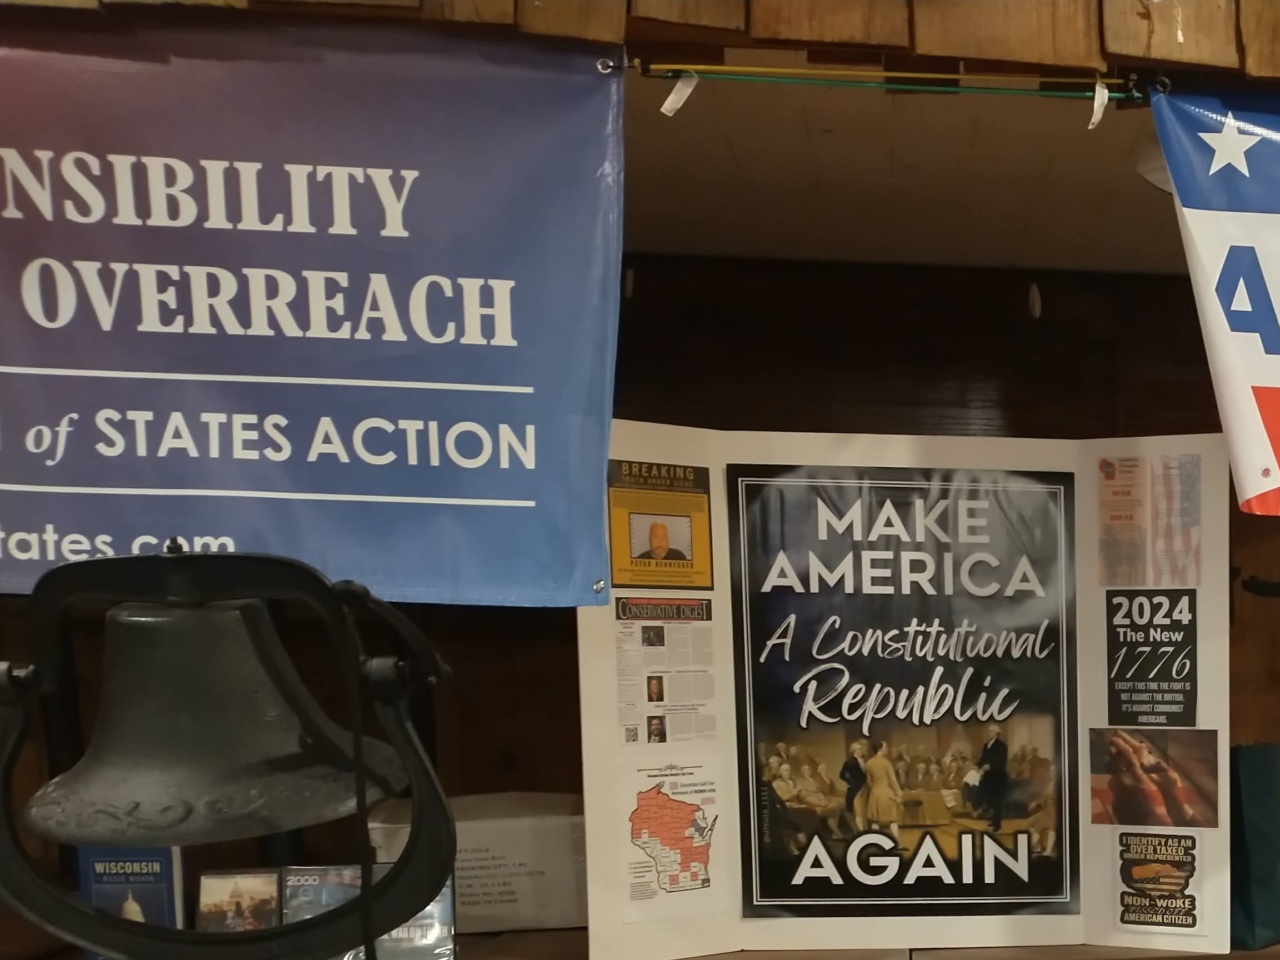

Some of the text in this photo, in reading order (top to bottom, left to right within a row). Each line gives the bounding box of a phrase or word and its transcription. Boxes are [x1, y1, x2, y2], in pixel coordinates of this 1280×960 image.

[20, 257, 518, 347] OVERREACH
[25, 409, 537, 469] of STATES ACTION
[622, 462, 694, 480] BREAKING
[817, 497, 990, 544] MAKE
[760, 550, 1047, 597] AMERICA
[619, 599, 708, 620] CONSERVATIVE DIGEST
[1112, 596, 1192, 625] 2024
[759, 613, 1055, 663] A Constitutional
[1116, 628, 1184, 642] The New
[1110, 645, 1192, 679] 1776
[1185, 682, 1190, 690] IS
[792, 662, 1021, 737] Republic
[1123, 836, 1191, 847] I IDENTIFY AS AN
[1130, 845, 1184, 855] OVER TAXED
[94, 862, 160, 874] WISCONSIN
[791, 833, 1029, 886] AGAIN
[1124, 895, 1192, 908] NON-WOKE
[1124, 912, 1192, 924] AMERICAN CITIZEN
